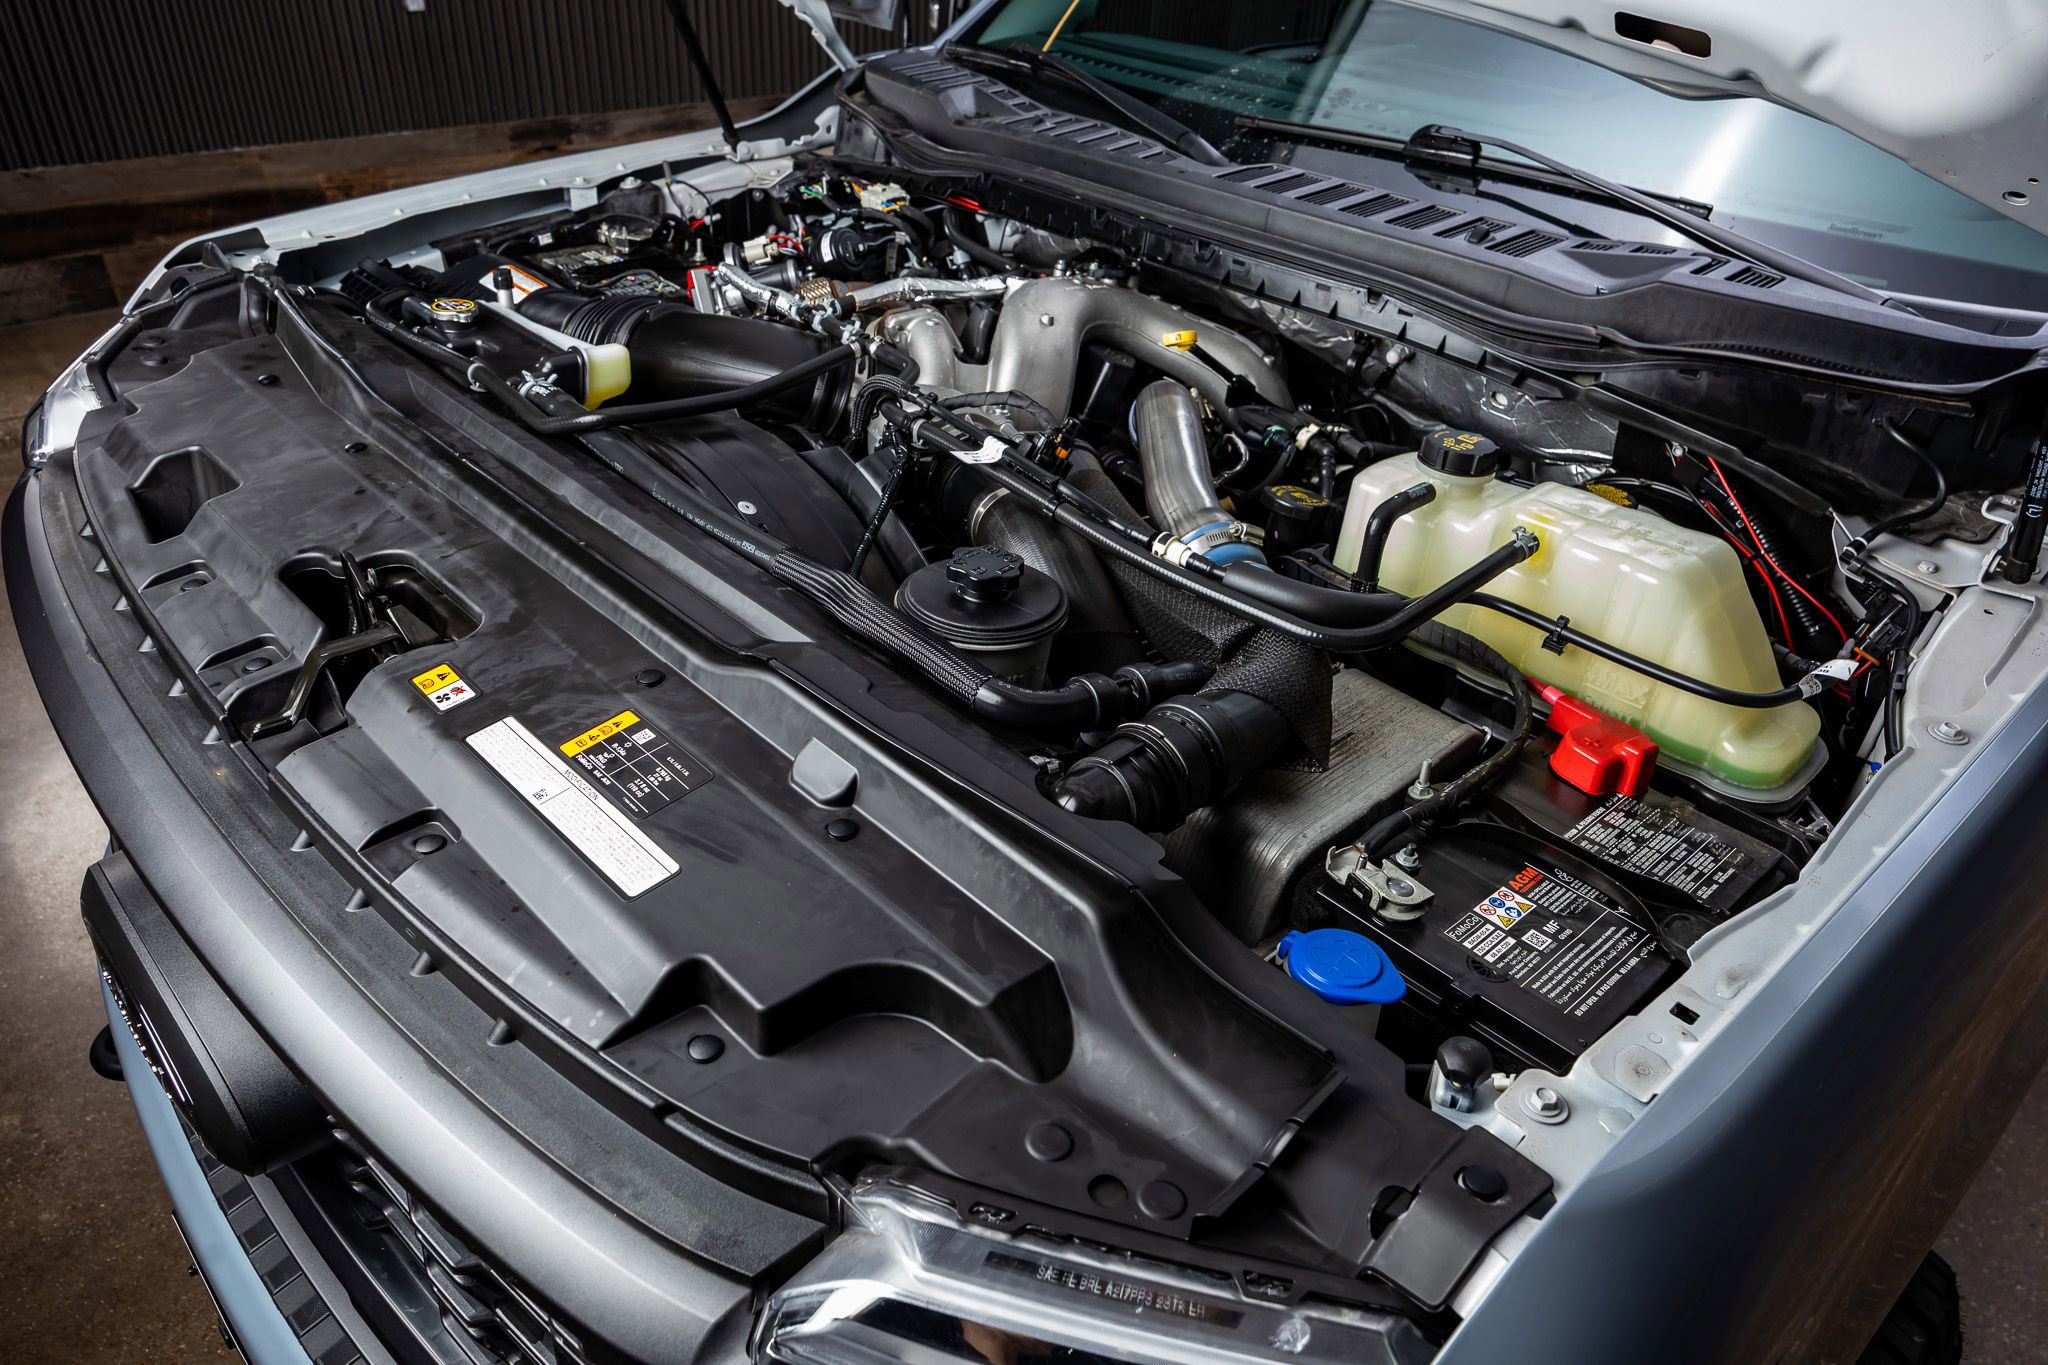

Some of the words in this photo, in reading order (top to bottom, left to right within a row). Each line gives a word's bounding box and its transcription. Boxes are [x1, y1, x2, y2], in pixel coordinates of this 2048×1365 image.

[576, 754, 593, 769] FoMoCo
[1509, 868, 1538, 890] AGM
[1449, 915, 1479, 940] FoMoCo
[1543, 920, 1559, 934] MF
[1036, 1264, 1059, 1284] SAE
